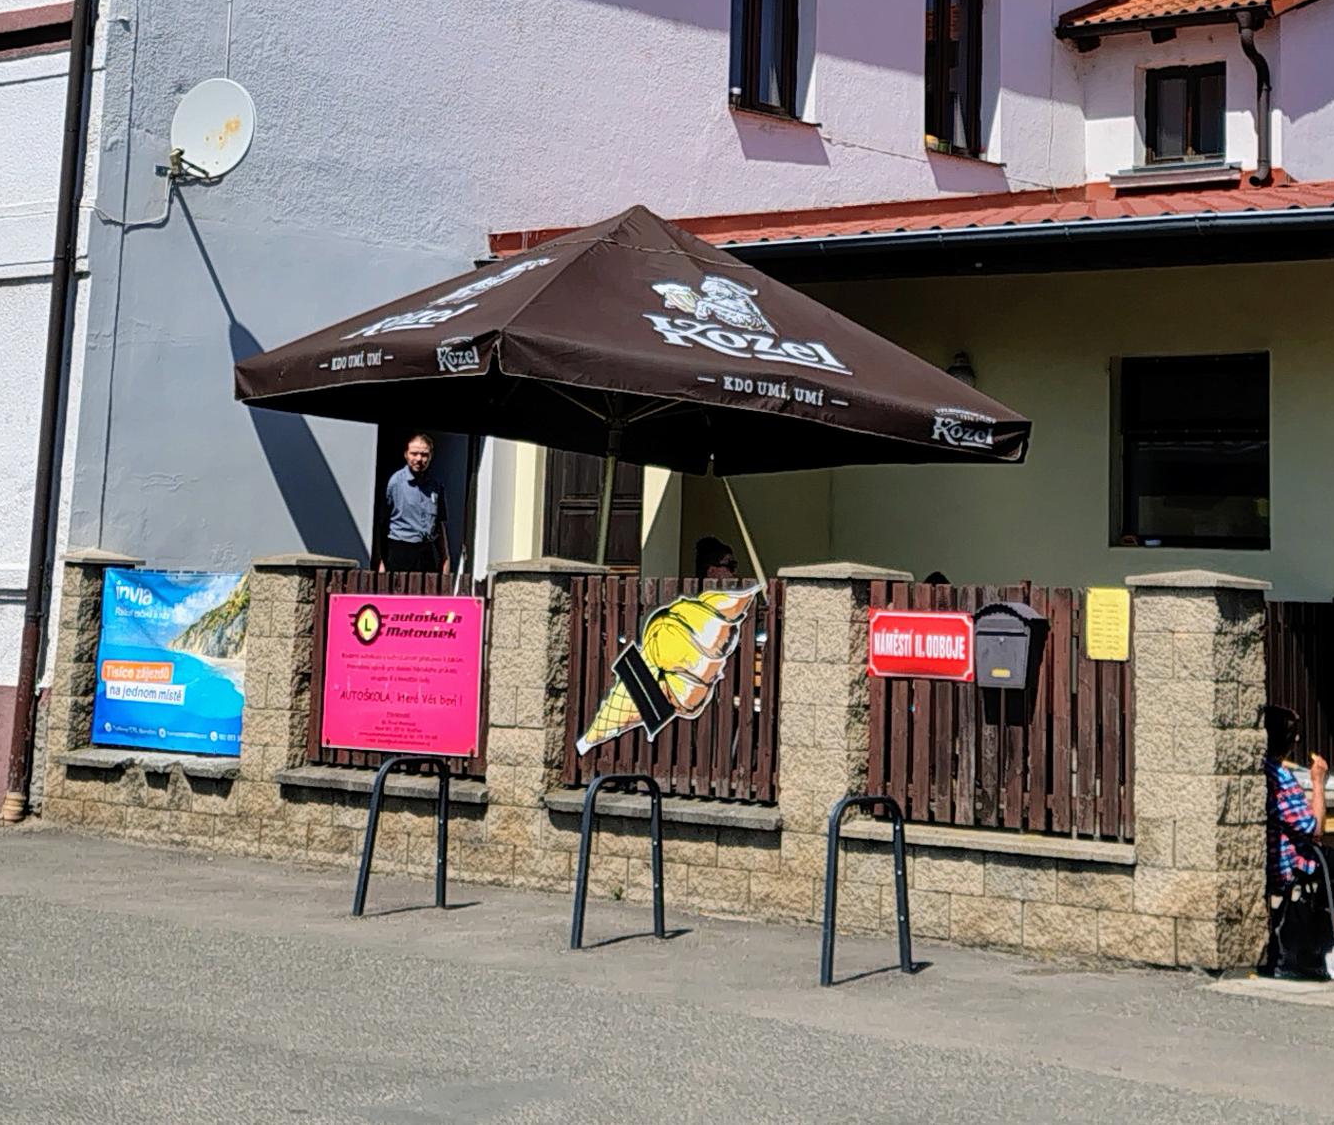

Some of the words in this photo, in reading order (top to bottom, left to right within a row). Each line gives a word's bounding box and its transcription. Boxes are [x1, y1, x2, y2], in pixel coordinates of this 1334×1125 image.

[643, 313, 854, 375] Kozel
[436, 346, 480, 373] Kozel
[723, 376, 753, 393] KDO
[757, 382, 791, 401] UMÍ,
[793, 388, 824, 406] UMÍ
[931, 416, 994, 449] Kozel
[115, 580, 154, 606] invia
[364, 618, 372, 632] L
[390, 610, 463, 624] autoškola
[873, 628, 914, 657] NÁMĚSTÍ
[926, 635, 966, 660] ODBOJE
[109, 686, 121, 696] na
[122, 686, 157, 699] jednom
[158, 688, 182, 702] místě
